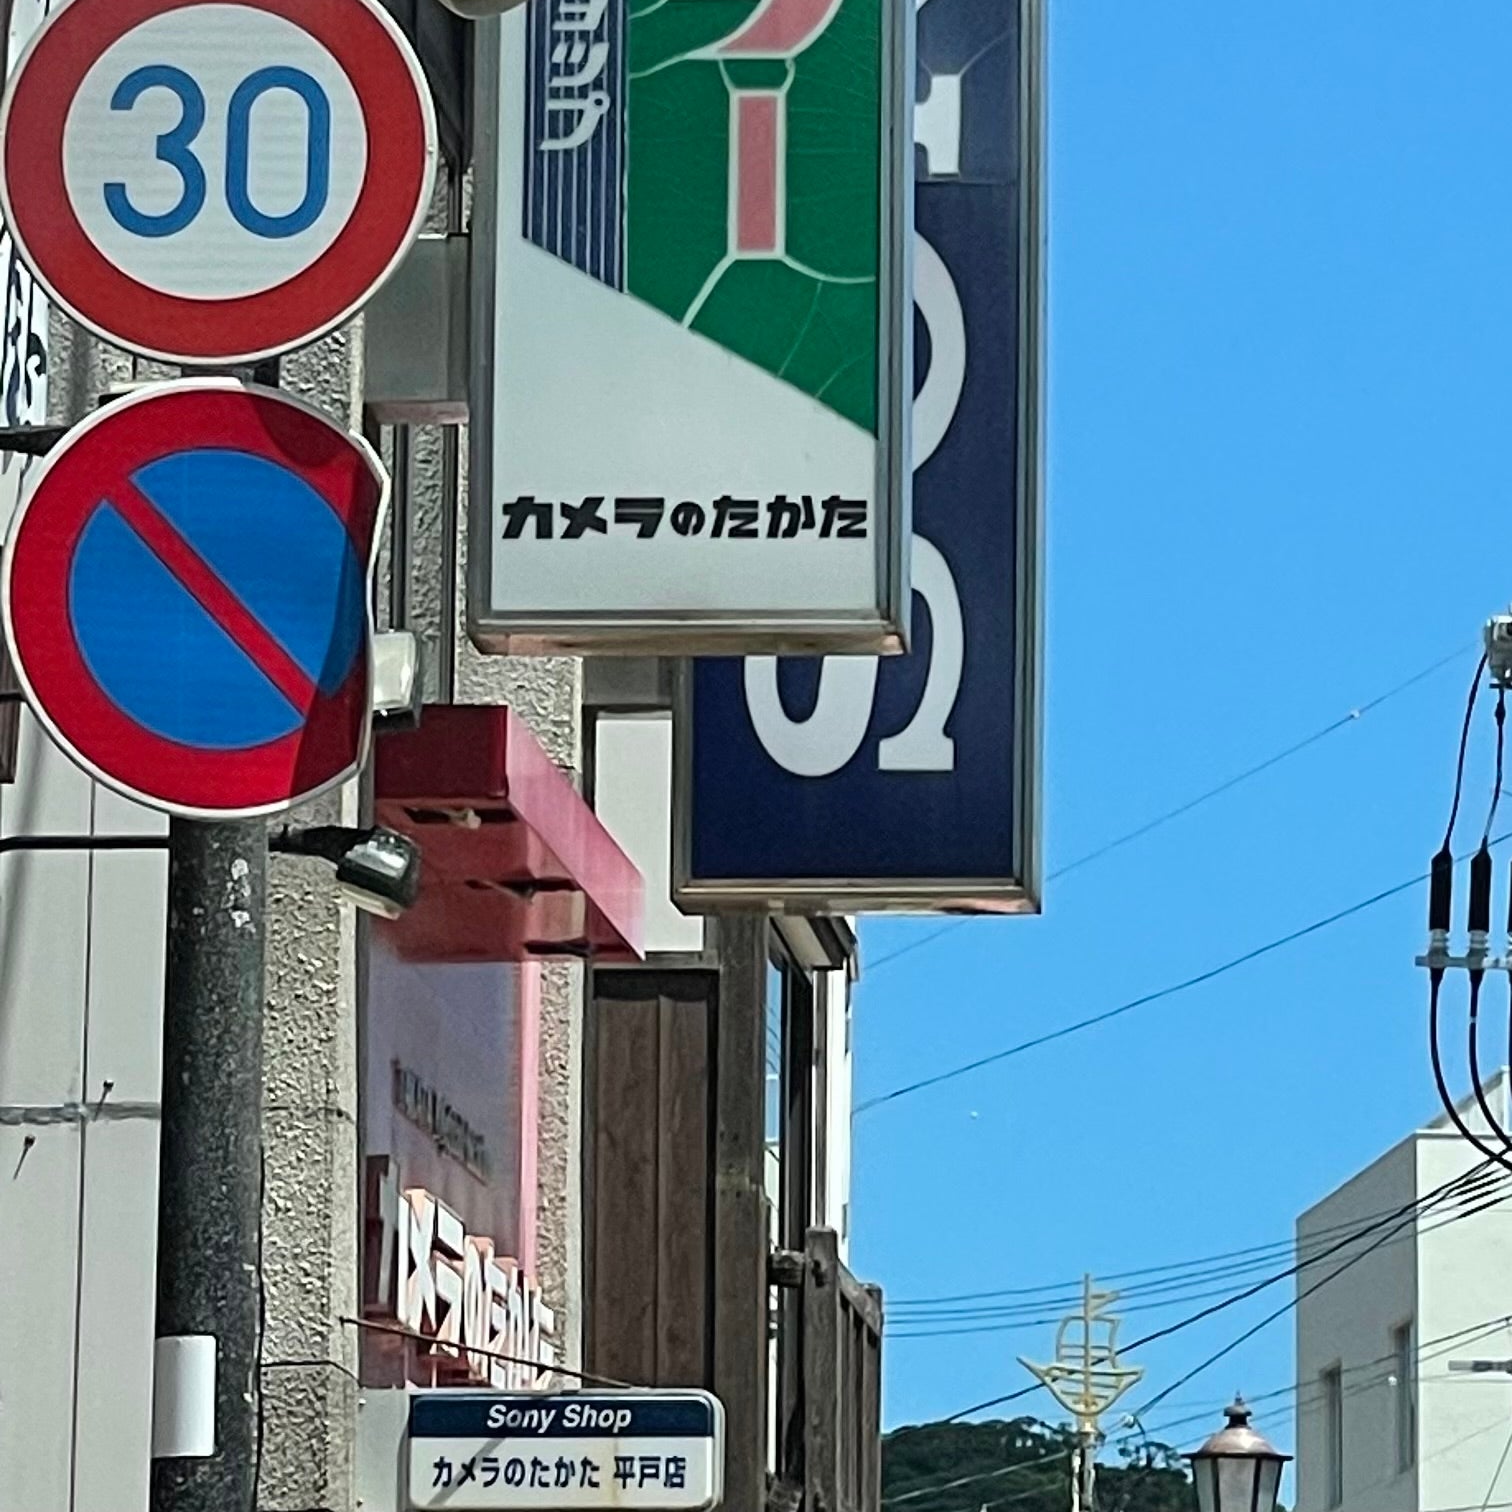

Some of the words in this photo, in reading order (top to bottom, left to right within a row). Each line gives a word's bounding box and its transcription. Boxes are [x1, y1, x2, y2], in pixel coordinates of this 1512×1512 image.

[103, 64, 331, 239] 30
[501, 494, 868, 540] カメラのたかた
[486, 1403, 556, 1434] Sony
[562, 1403, 633, 1434] Shop
[431, 1454, 601, 1489] カメラのたかた
[613, 1454, 687, 1490] 平戸店
